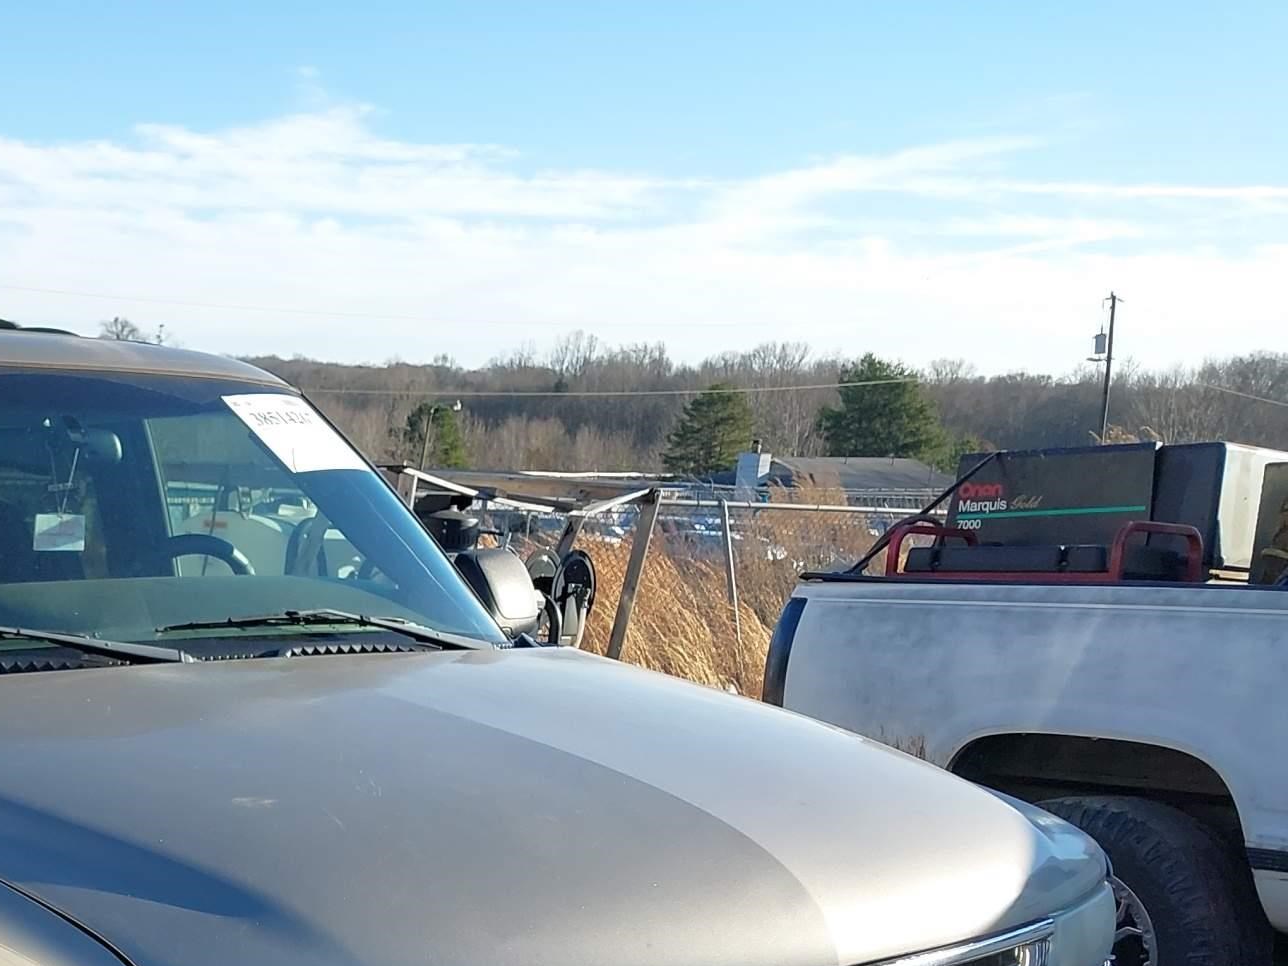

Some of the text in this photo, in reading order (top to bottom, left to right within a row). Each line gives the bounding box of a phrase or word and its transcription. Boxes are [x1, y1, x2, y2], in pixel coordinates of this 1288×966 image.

[958, 482, 1002, 499] Onan
[957, 494, 1044, 514] Marquis Gold
[956, 519, 982, 530] 7000
